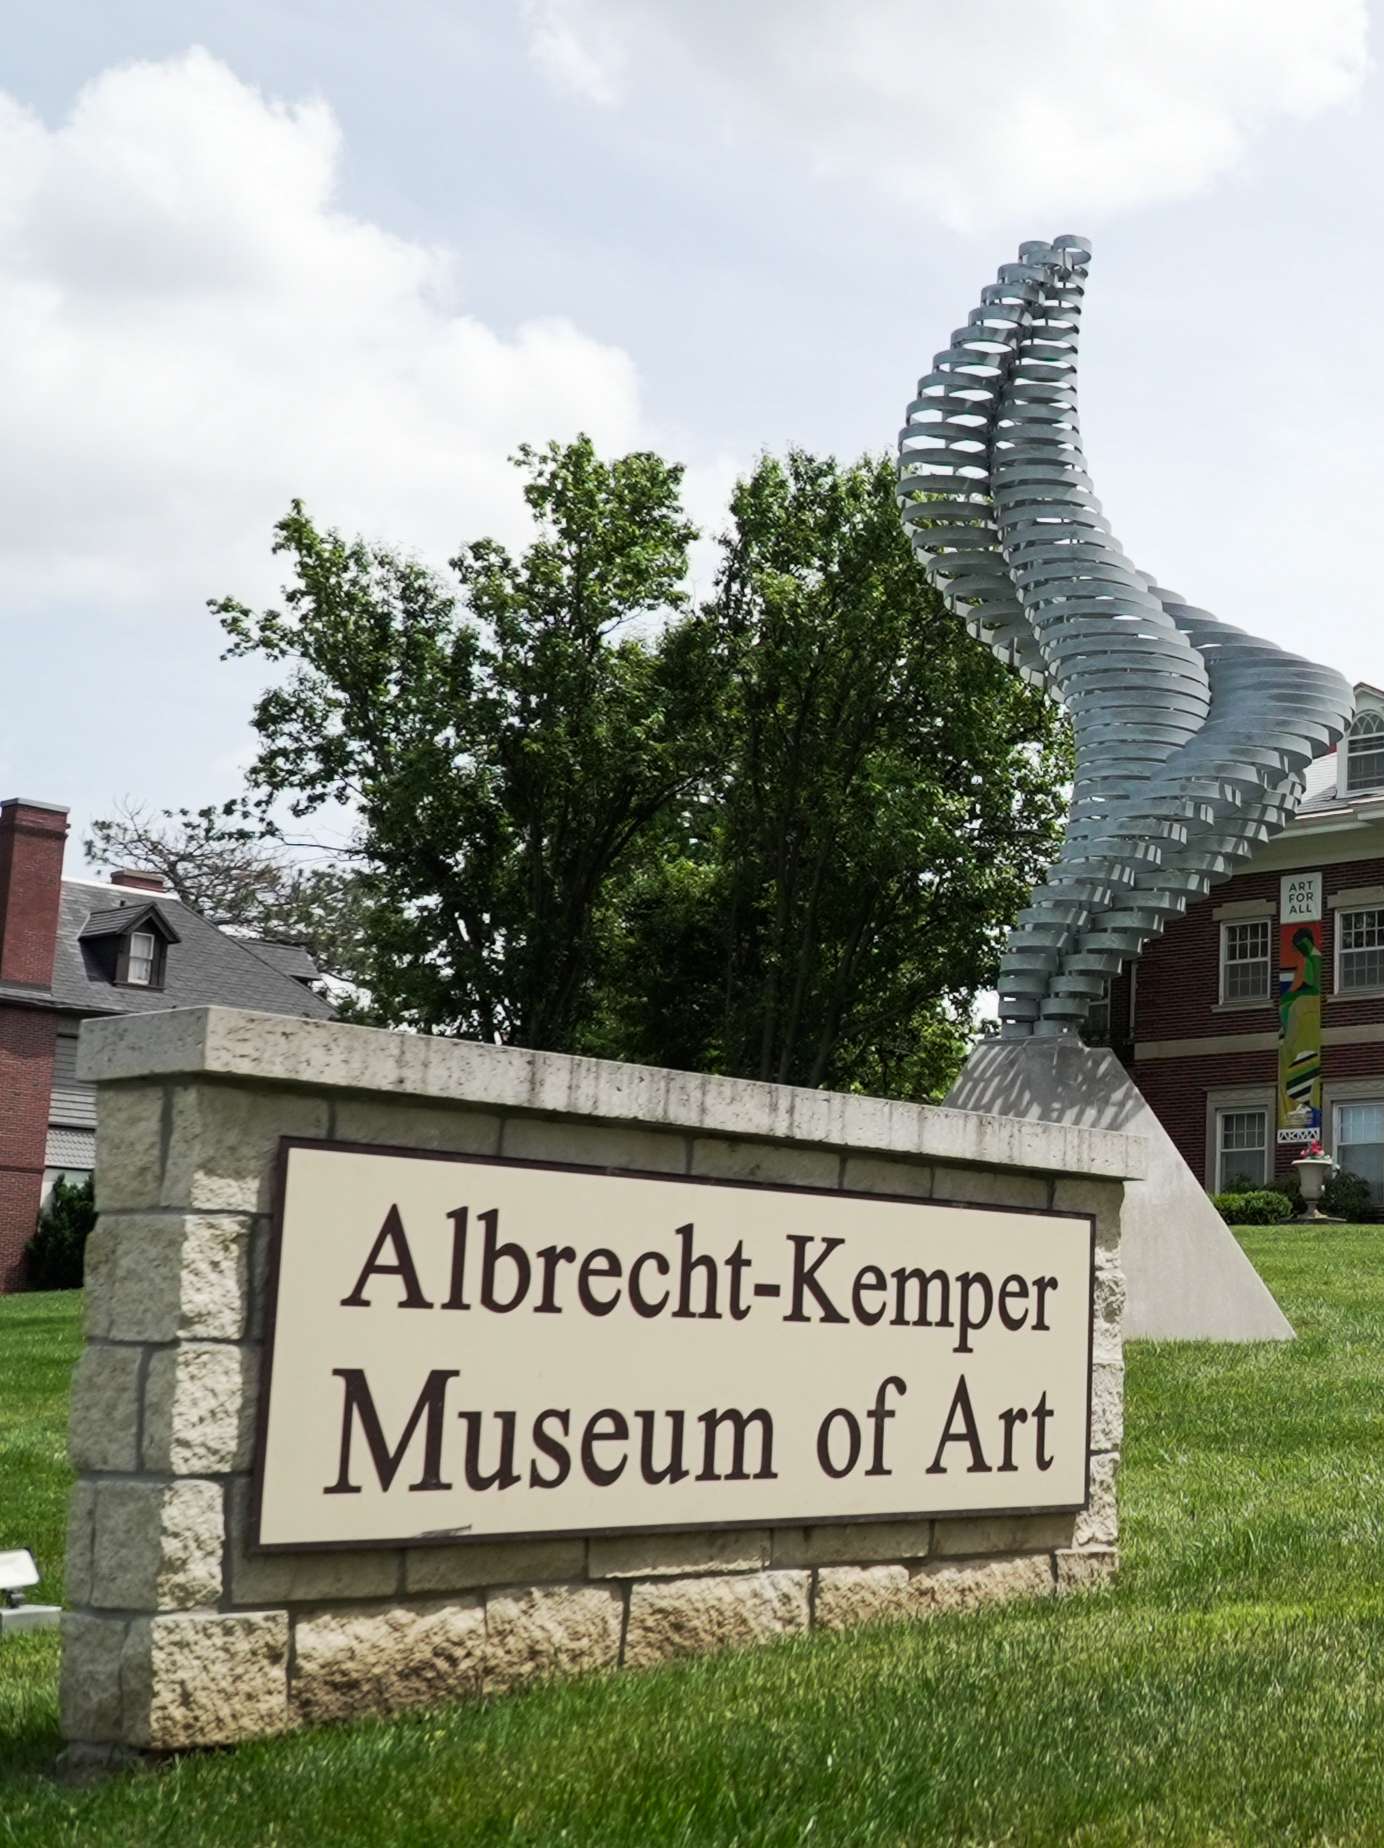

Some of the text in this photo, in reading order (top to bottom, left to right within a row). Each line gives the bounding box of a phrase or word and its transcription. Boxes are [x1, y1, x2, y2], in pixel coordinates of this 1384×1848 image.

[1289, 880, 1312, 892] ART
[1288, 891, 1313, 904] FOR
[1289, 903, 1312, 915] ALL
[1279, 1129, 1318, 1141] AKMA
[341, 1203, 1058, 1353] Albrecht-Kemper
[323, 1369, 1054, 1494] Museum of Art
